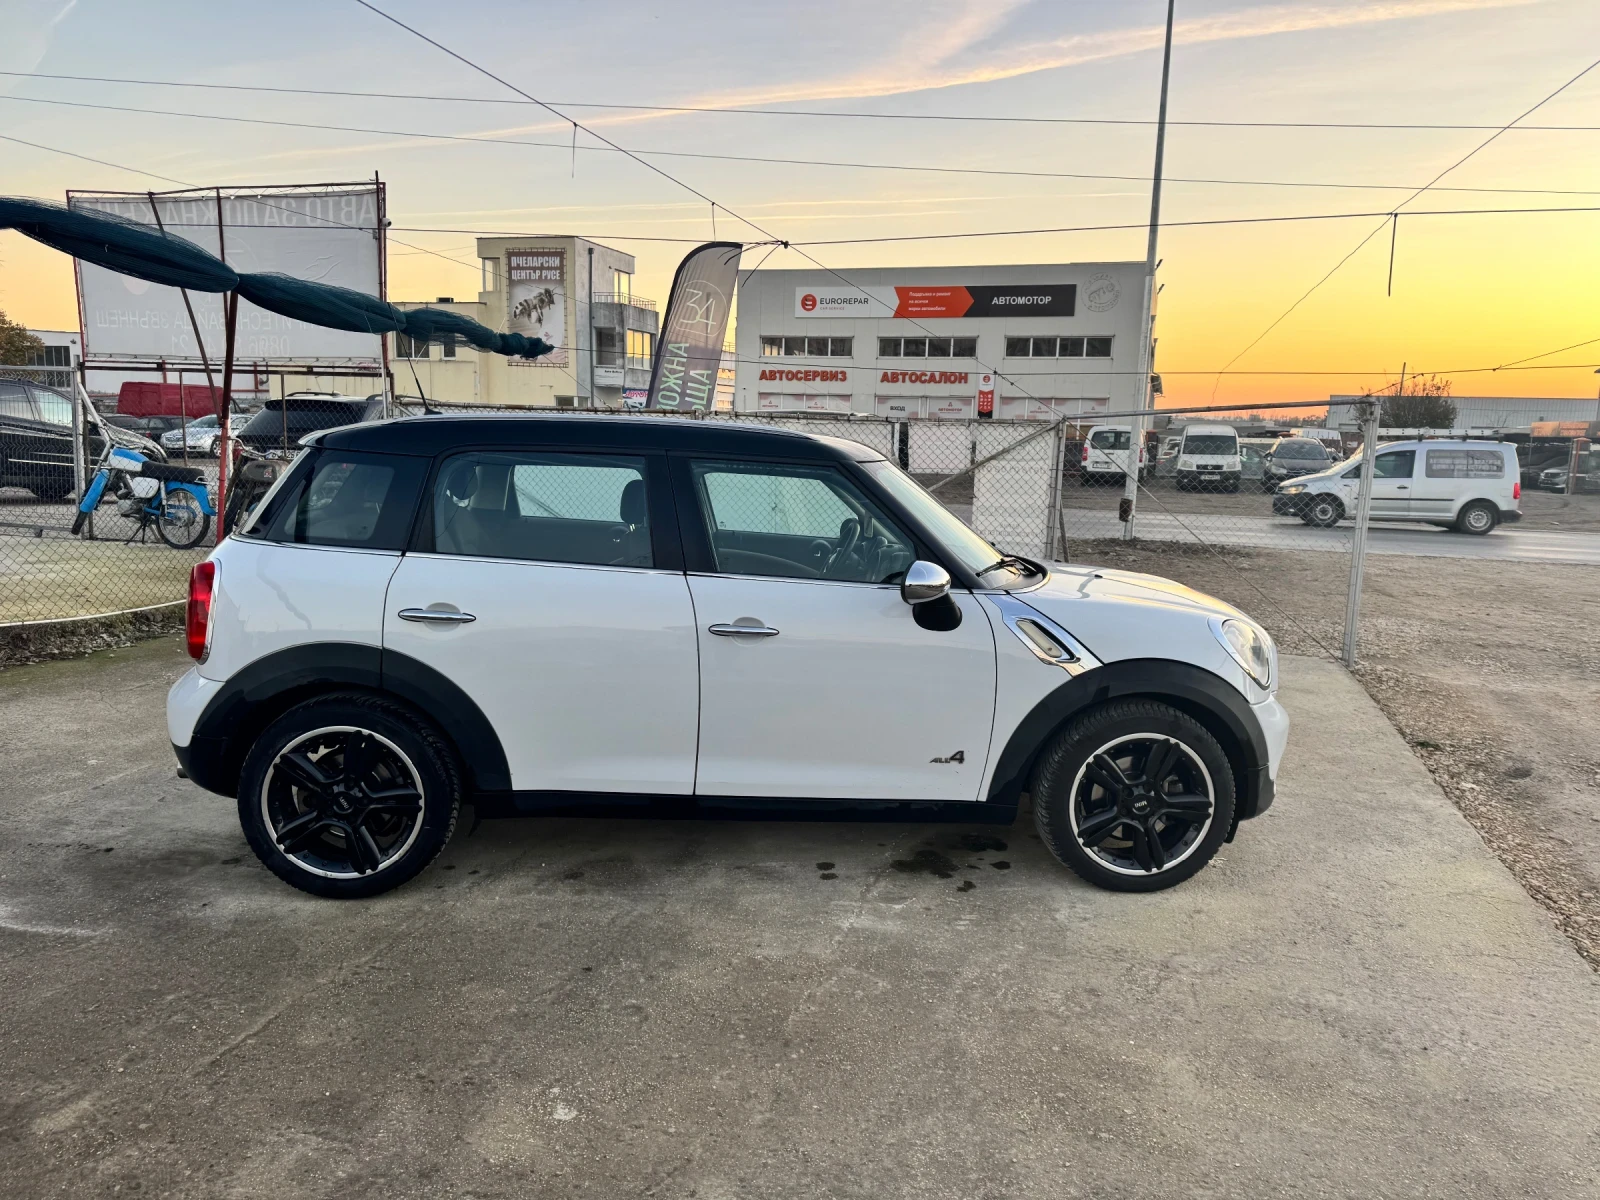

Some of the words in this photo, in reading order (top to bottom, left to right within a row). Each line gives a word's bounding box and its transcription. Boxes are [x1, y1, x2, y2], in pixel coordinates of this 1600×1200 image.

[511, 256, 560, 268] ПЧЕЛАРСКИ
[511, 270, 541, 281] ЦЕНТЪР
[542, 270, 560, 280] РУСЕ
[819, 297, 869, 305] EUROREPAR
[991, 296, 1052, 305] АВТОМОТОР
[656, 342, 690, 410] ОЖНА
[759, 369, 847, 382] АВТОСЕРВИЗ
[880, 371, 969, 384] АВТОСАЛОН
